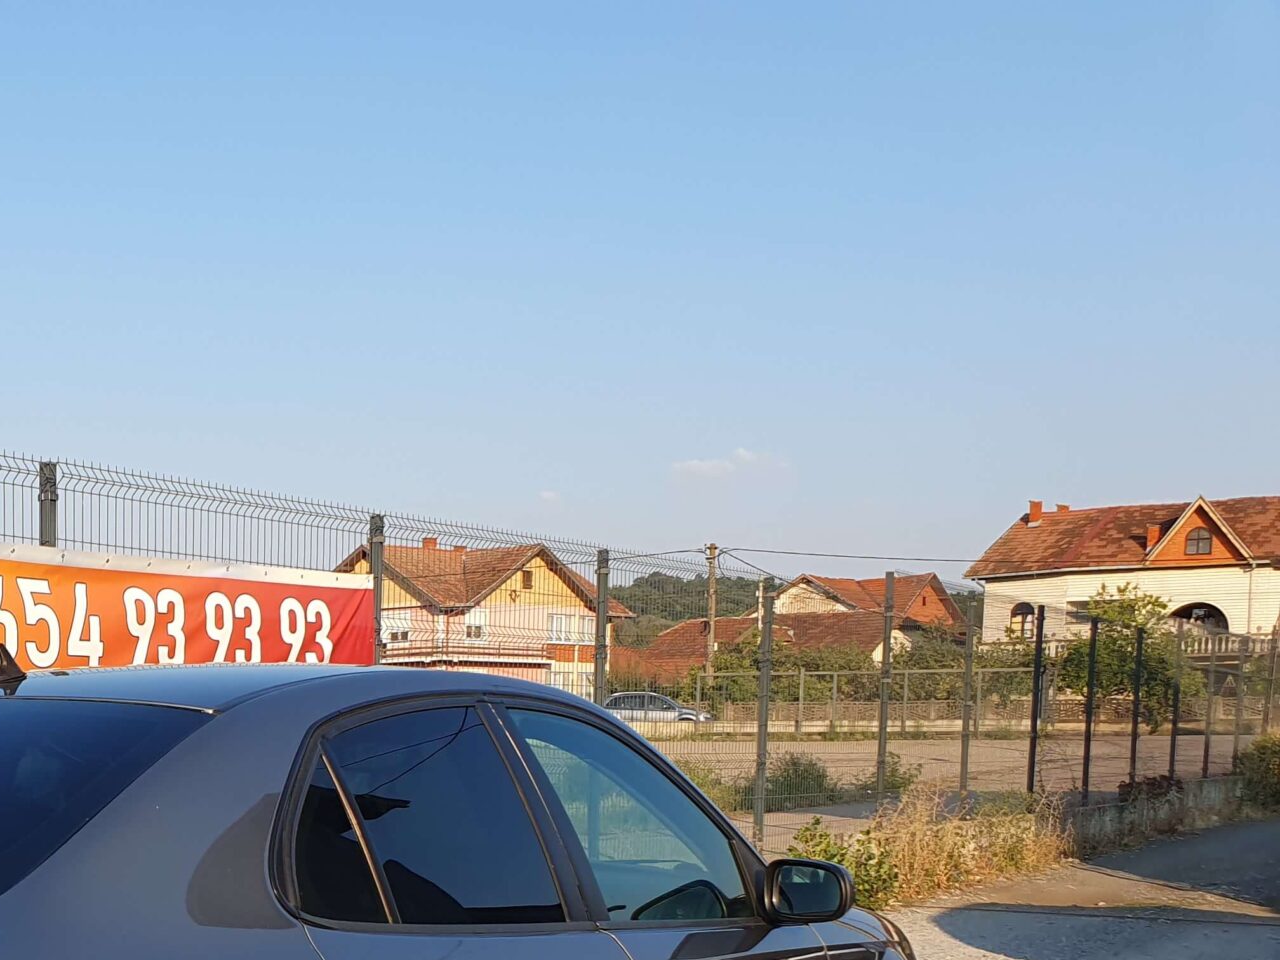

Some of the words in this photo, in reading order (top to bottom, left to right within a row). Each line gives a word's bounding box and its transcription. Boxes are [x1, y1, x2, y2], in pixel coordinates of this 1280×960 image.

[122, 586, 186, 666] 93
[205, 591, 262, 665] 93
[279, 597, 334, 665] 93
